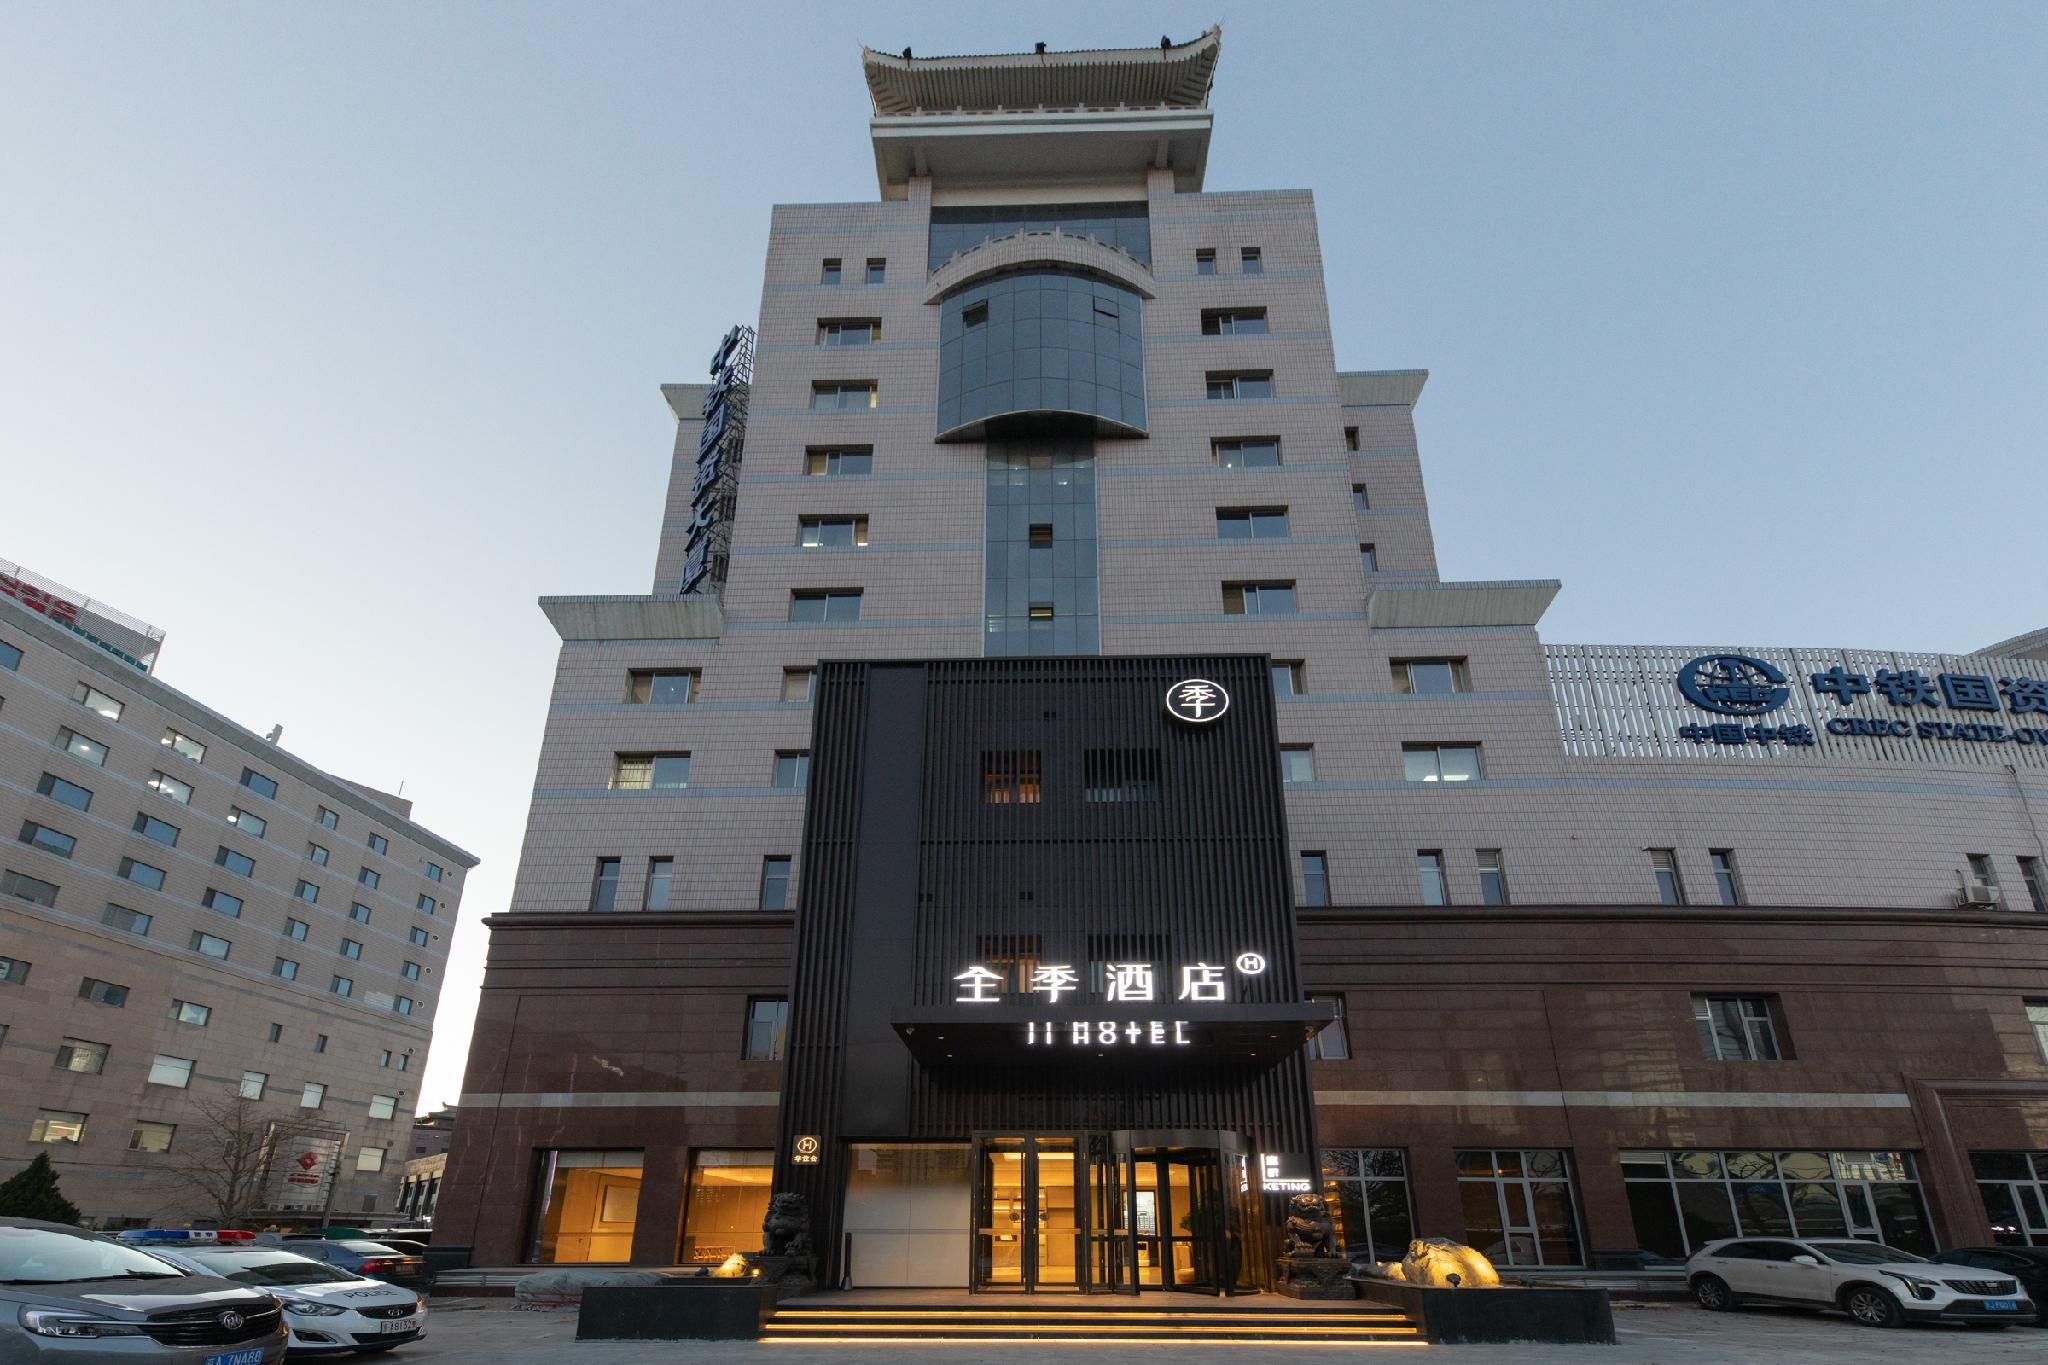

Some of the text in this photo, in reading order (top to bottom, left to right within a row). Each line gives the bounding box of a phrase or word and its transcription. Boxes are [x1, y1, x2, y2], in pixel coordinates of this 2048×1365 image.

[1178, 685, 1217, 718] 季
[1679, 722, 1815, 747] 中国中铁
[1826, 717, 1913, 738] CREC
[953, 962, 1226, 1003] 全季酒店
[1263, 1182, 1311, 1191] KETING
